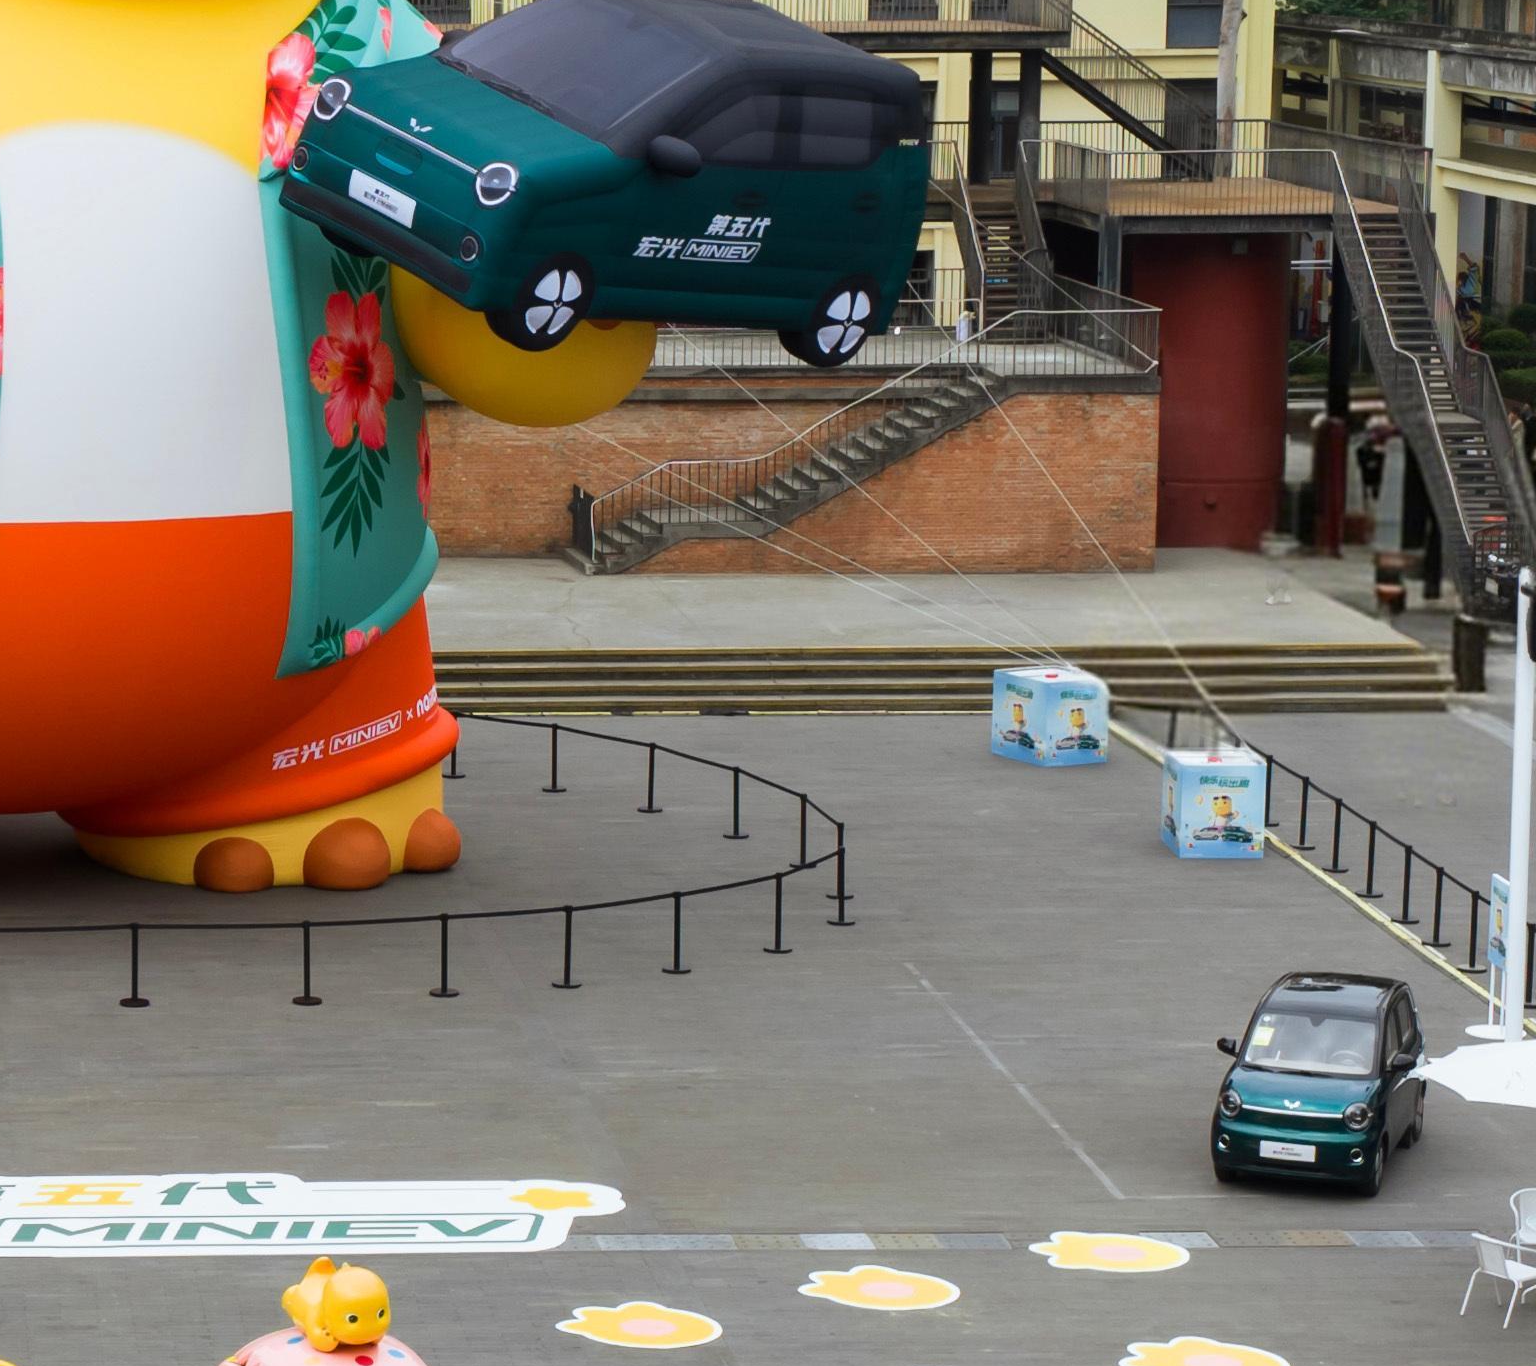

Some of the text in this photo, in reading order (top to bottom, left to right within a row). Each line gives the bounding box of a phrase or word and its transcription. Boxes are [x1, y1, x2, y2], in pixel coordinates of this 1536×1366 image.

[706, 215, 771, 238] 第五代
[634, 237, 757, 261] 宏光 MINIEV
[272, 739, 325, 770] 宏光
[333, 715, 399, 751] MINIEV
[10, 1217, 512, 1243] MINIEV
